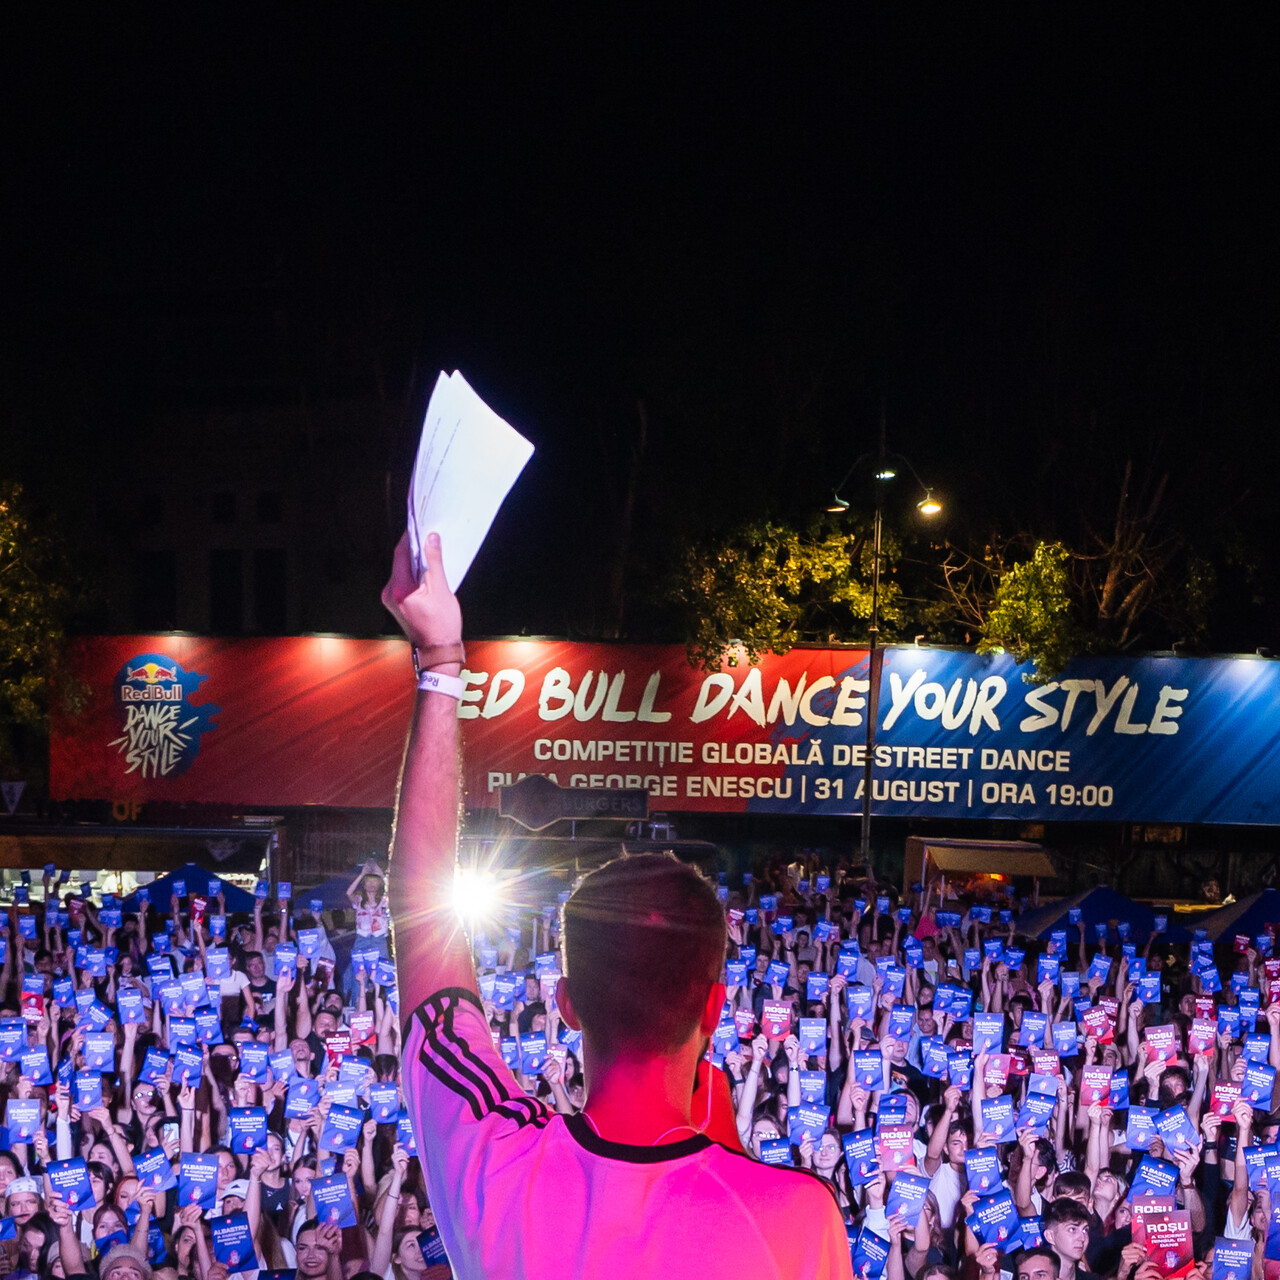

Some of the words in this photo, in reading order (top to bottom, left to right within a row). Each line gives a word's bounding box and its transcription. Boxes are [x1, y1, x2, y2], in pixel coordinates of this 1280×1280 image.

[122, 685, 151, 700] Red
[154, 684, 182, 700] Bull
[456, 668, 525, 720] ED
[538, 667, 671, 722] BULL
[689, 667, 869, 728] DANCE
[882, 669, 1007, 736] YOUR
[1020, 675, 1189, 736] STYLE
[123, 703, 181, 732] DANCE
[128, 722, 187, 752] YOUR
[124, 739, 183, 778] STYLE
[701, 739, 824, 765] GLOBALĂ
[833, 745, 866, 766] DE
[875, 746, 973, 770] STREET
[981, 749, 1070, 772] DANCE
[687, 776, 792, 799] ENESCU
[815, 778, 843, 799] 31
[854, 780, 960, 803] AUGUST
[982, 782, 1036, 805] ORA
[1045, 784, 1113, 807] 19:00
[1147, 1221, 1188, 1234] ROȘU
